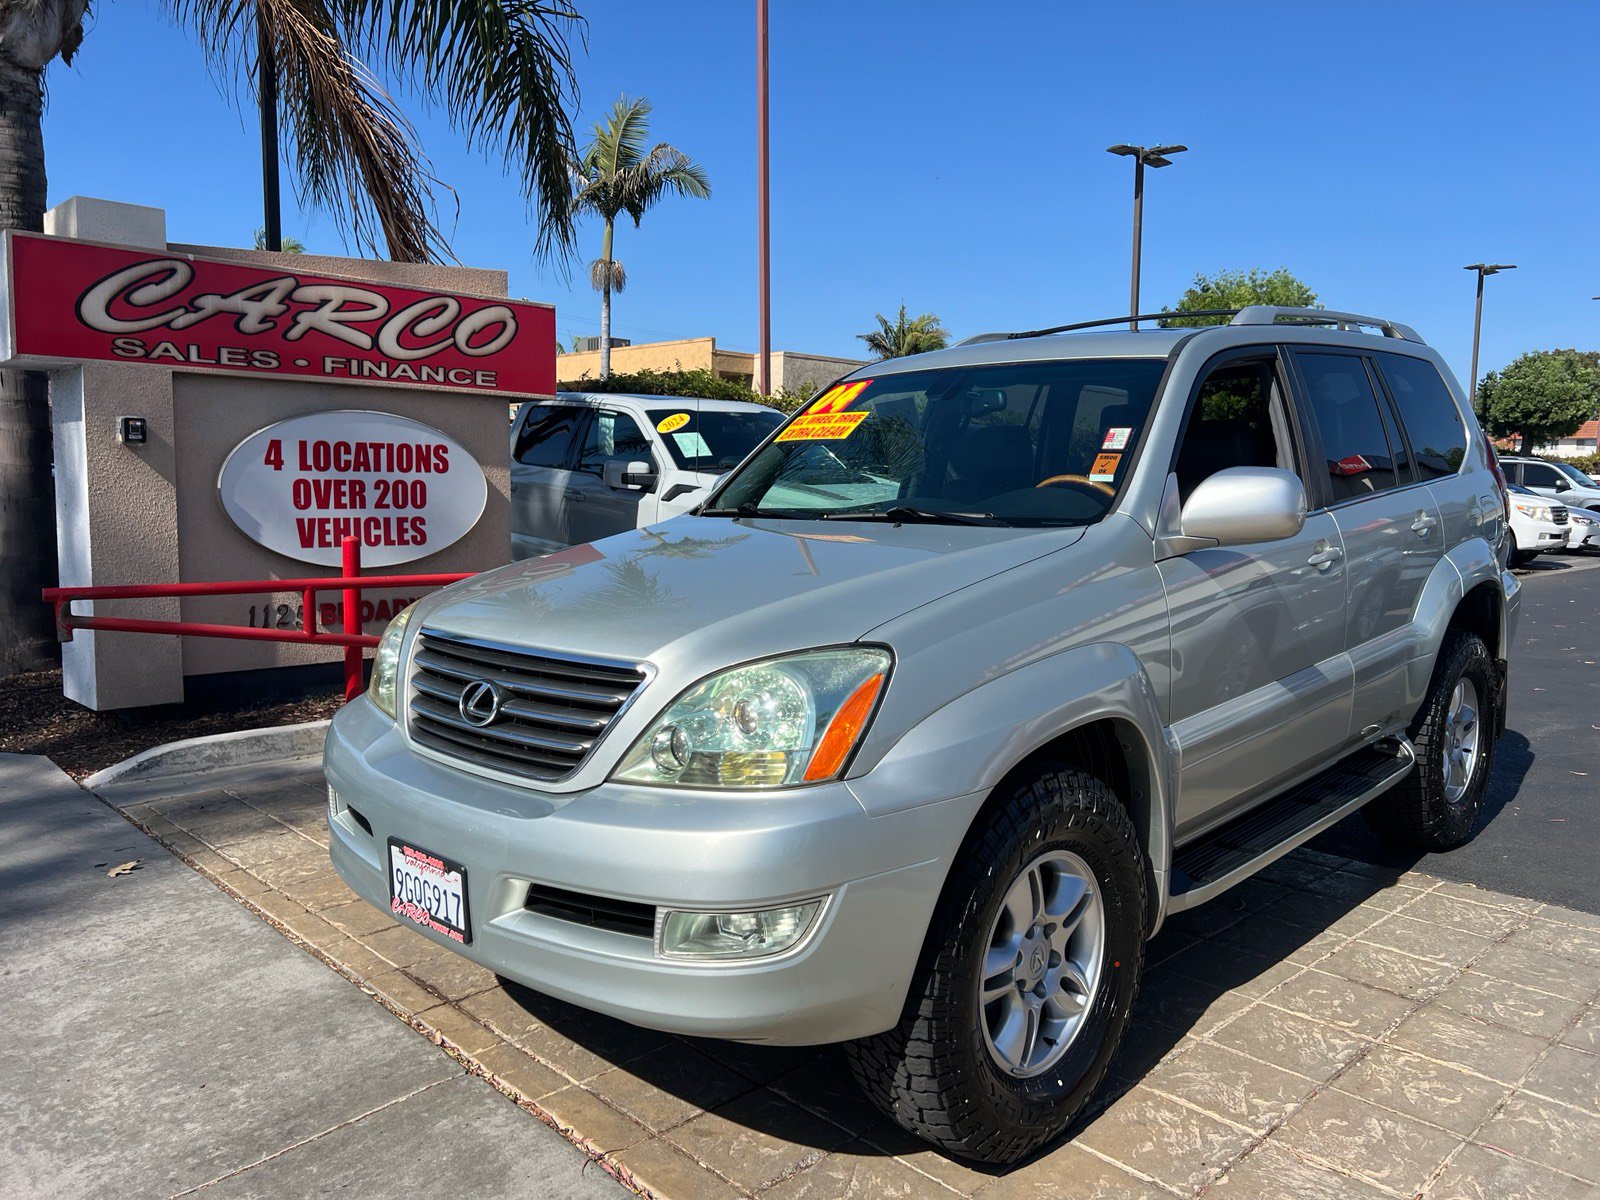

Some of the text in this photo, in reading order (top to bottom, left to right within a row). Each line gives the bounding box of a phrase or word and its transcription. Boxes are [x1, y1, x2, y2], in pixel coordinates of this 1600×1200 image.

[75, 258, 518, 361] CARCO
[112, 337, 498, 387] SALES FINANCE
[663, 414, 685, 431] 2024
[780, 425, 851, 440] EXTRA CLEAN
[834, 413, 866, 423] DRIVE
[264, 439, 450, 474] 4 LOCATIONS
[292, 478, 427, 511] OVER 200
[295, 516, 428, 549] VEHICLES
